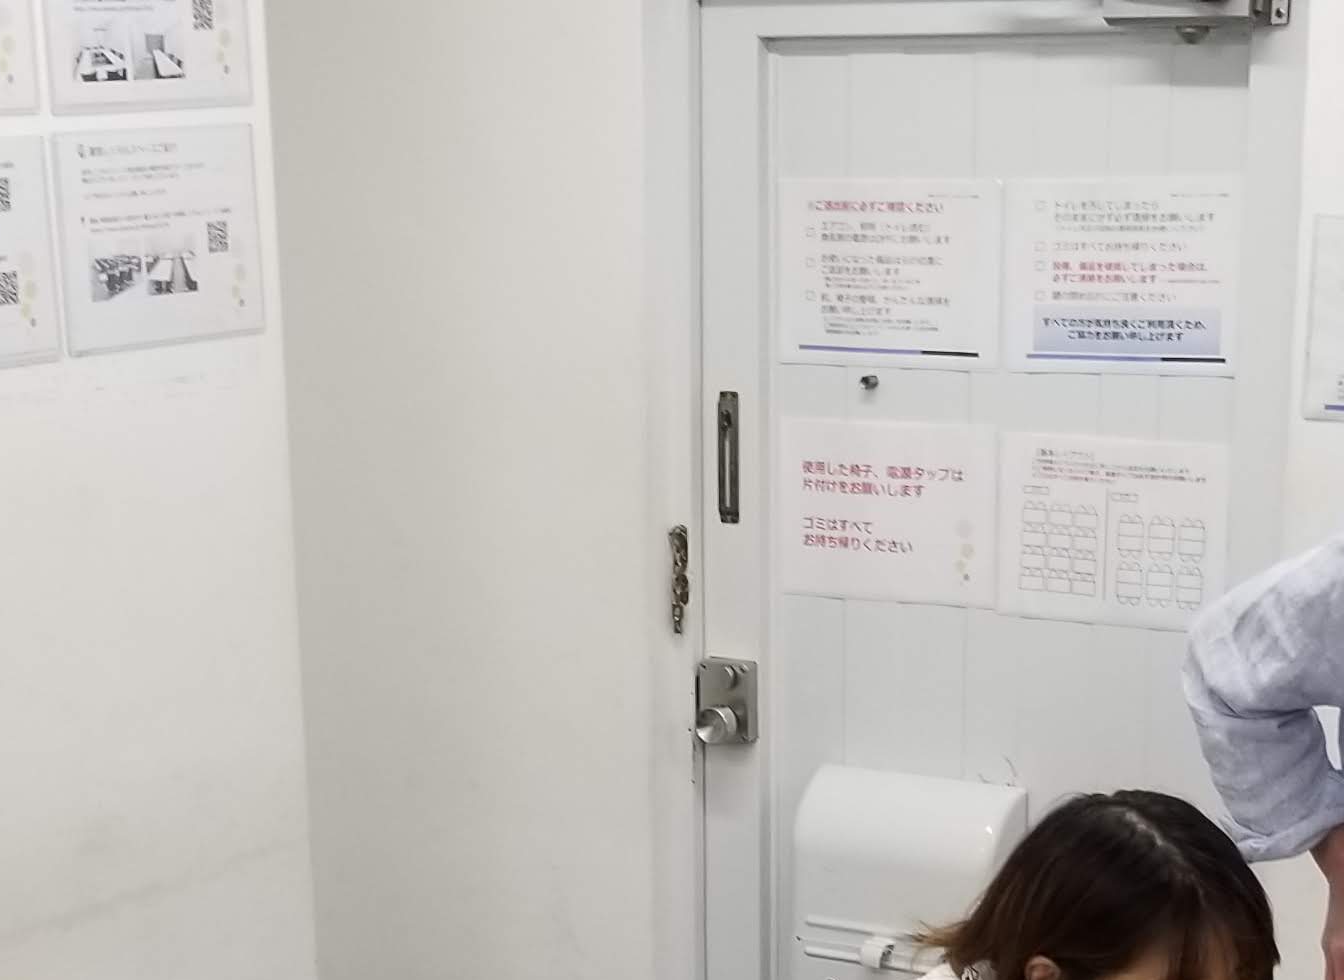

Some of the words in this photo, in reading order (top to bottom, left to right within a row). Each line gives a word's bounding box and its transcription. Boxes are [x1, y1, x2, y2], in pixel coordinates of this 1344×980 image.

[801, 478, 926, 498] 片付けをお願いします
[802, 516, 875, 535] ゴミはすべて
[802, 534, 914, 554] お持ち帰りください
